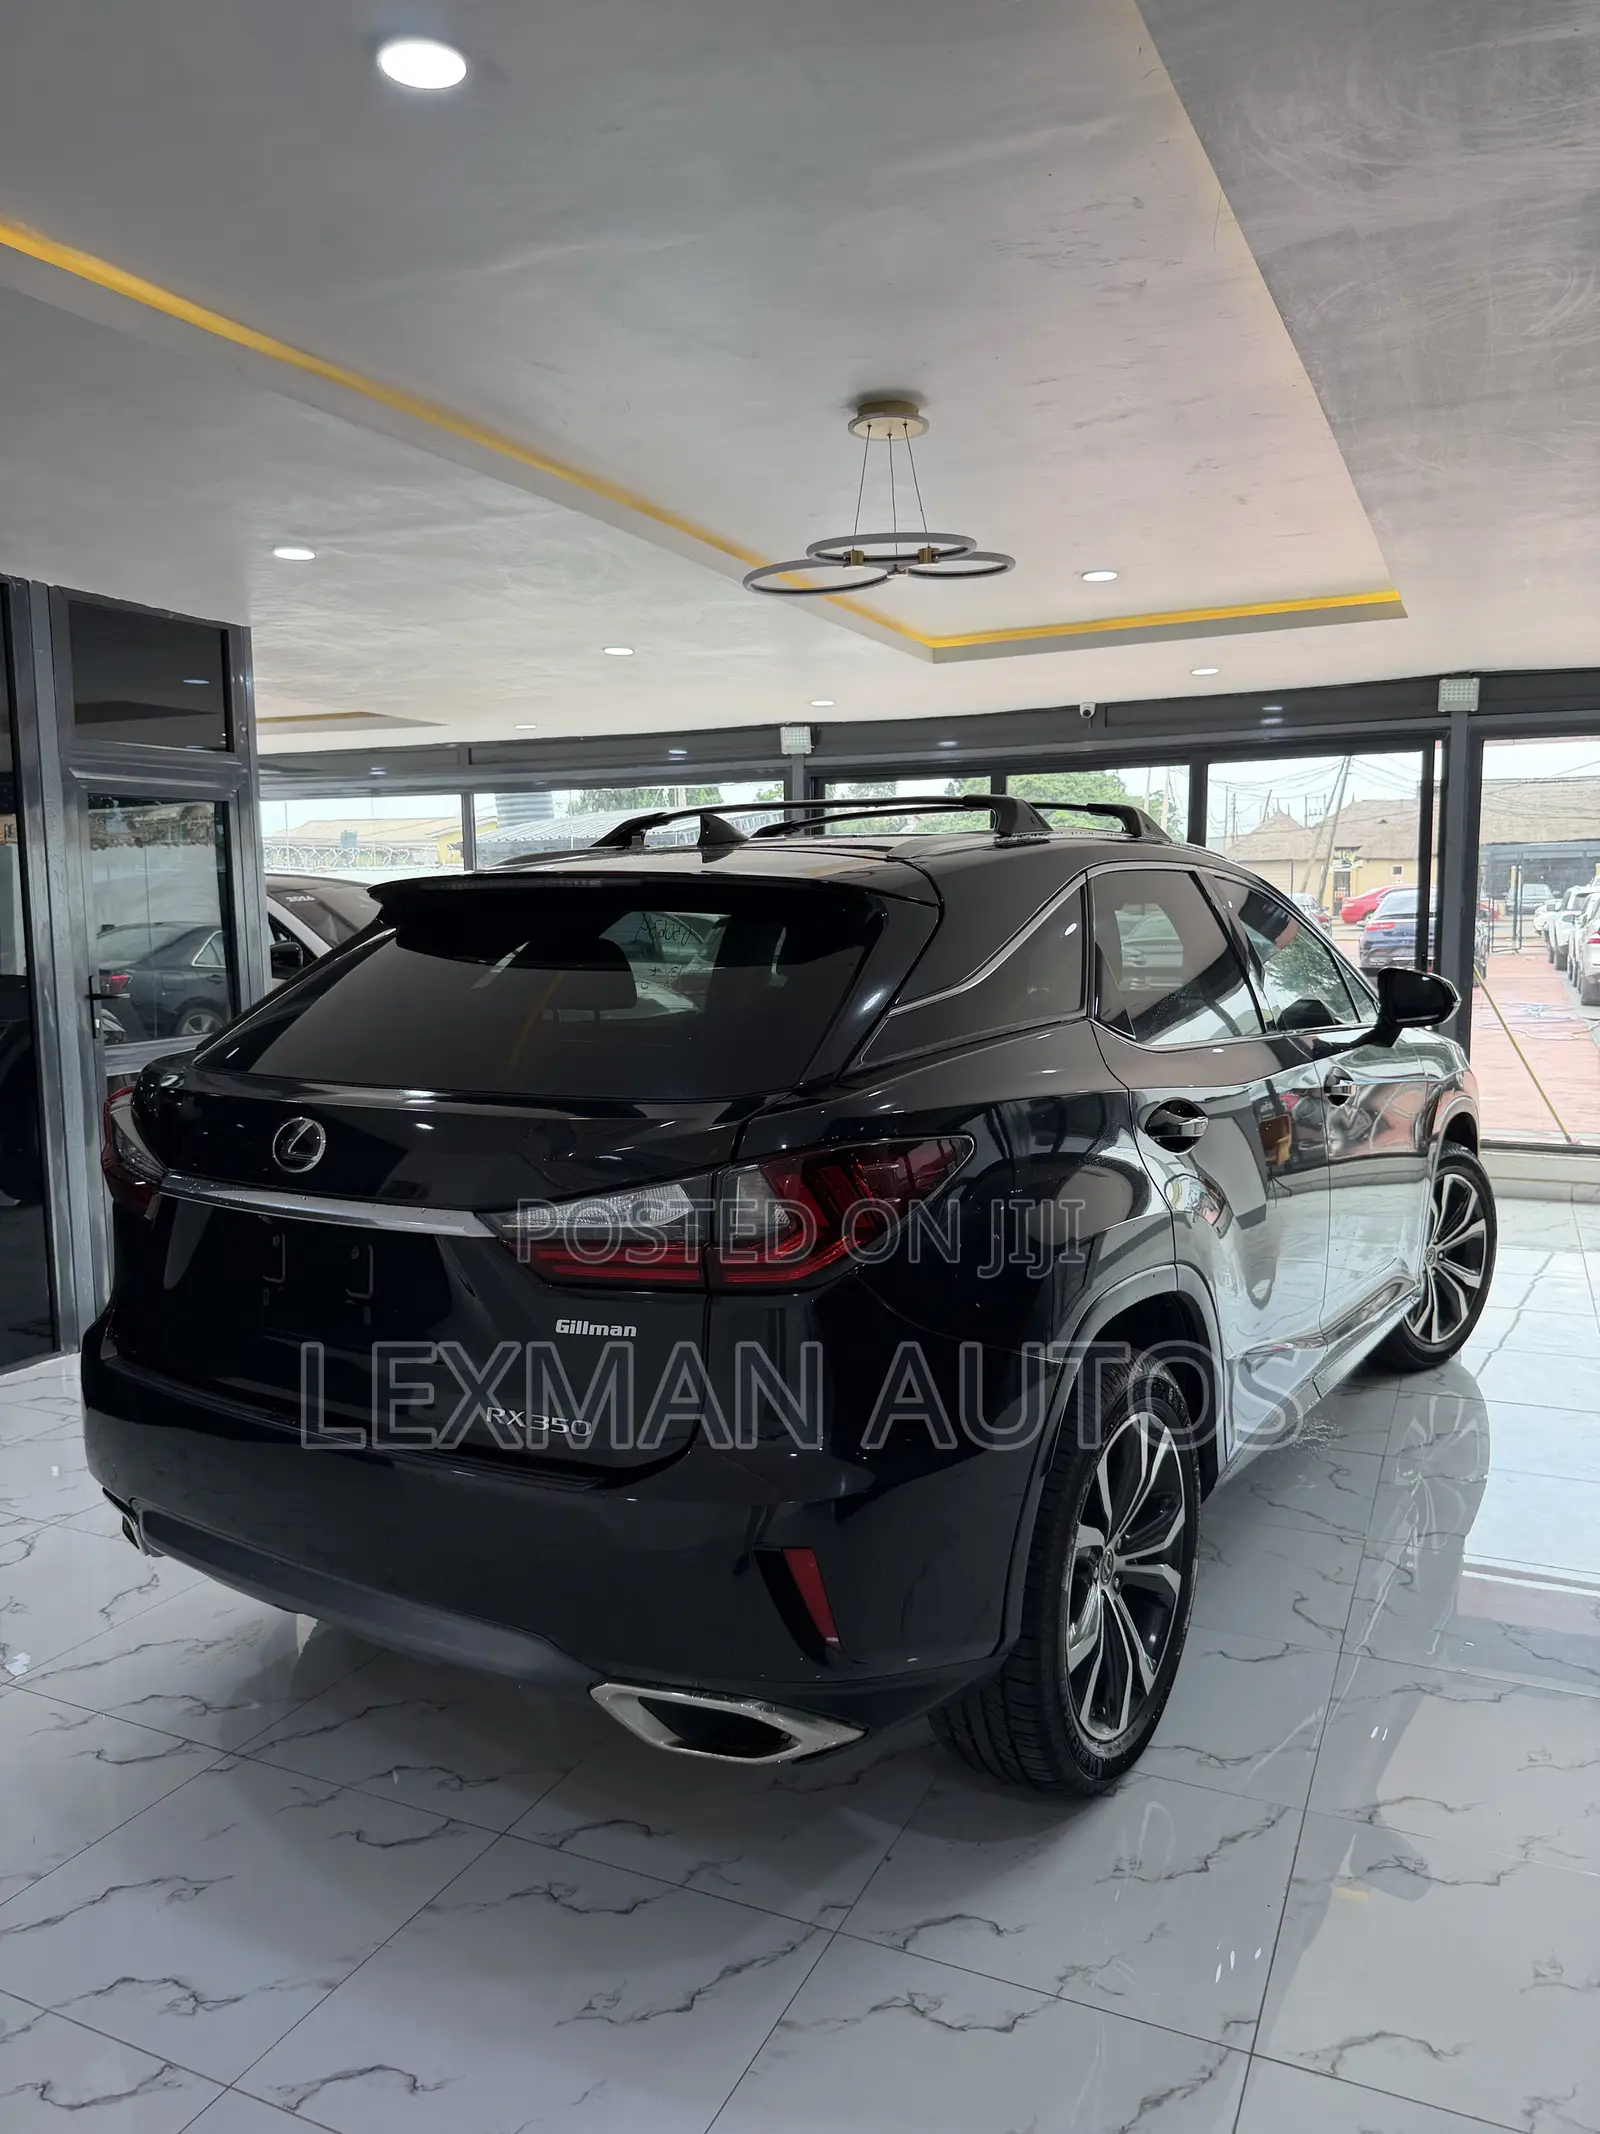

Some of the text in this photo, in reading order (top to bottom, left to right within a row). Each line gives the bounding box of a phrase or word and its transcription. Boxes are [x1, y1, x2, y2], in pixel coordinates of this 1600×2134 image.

[555, 1319, 637, 1337] Gillman
[486, 1406, 592, 1437] RX 350
